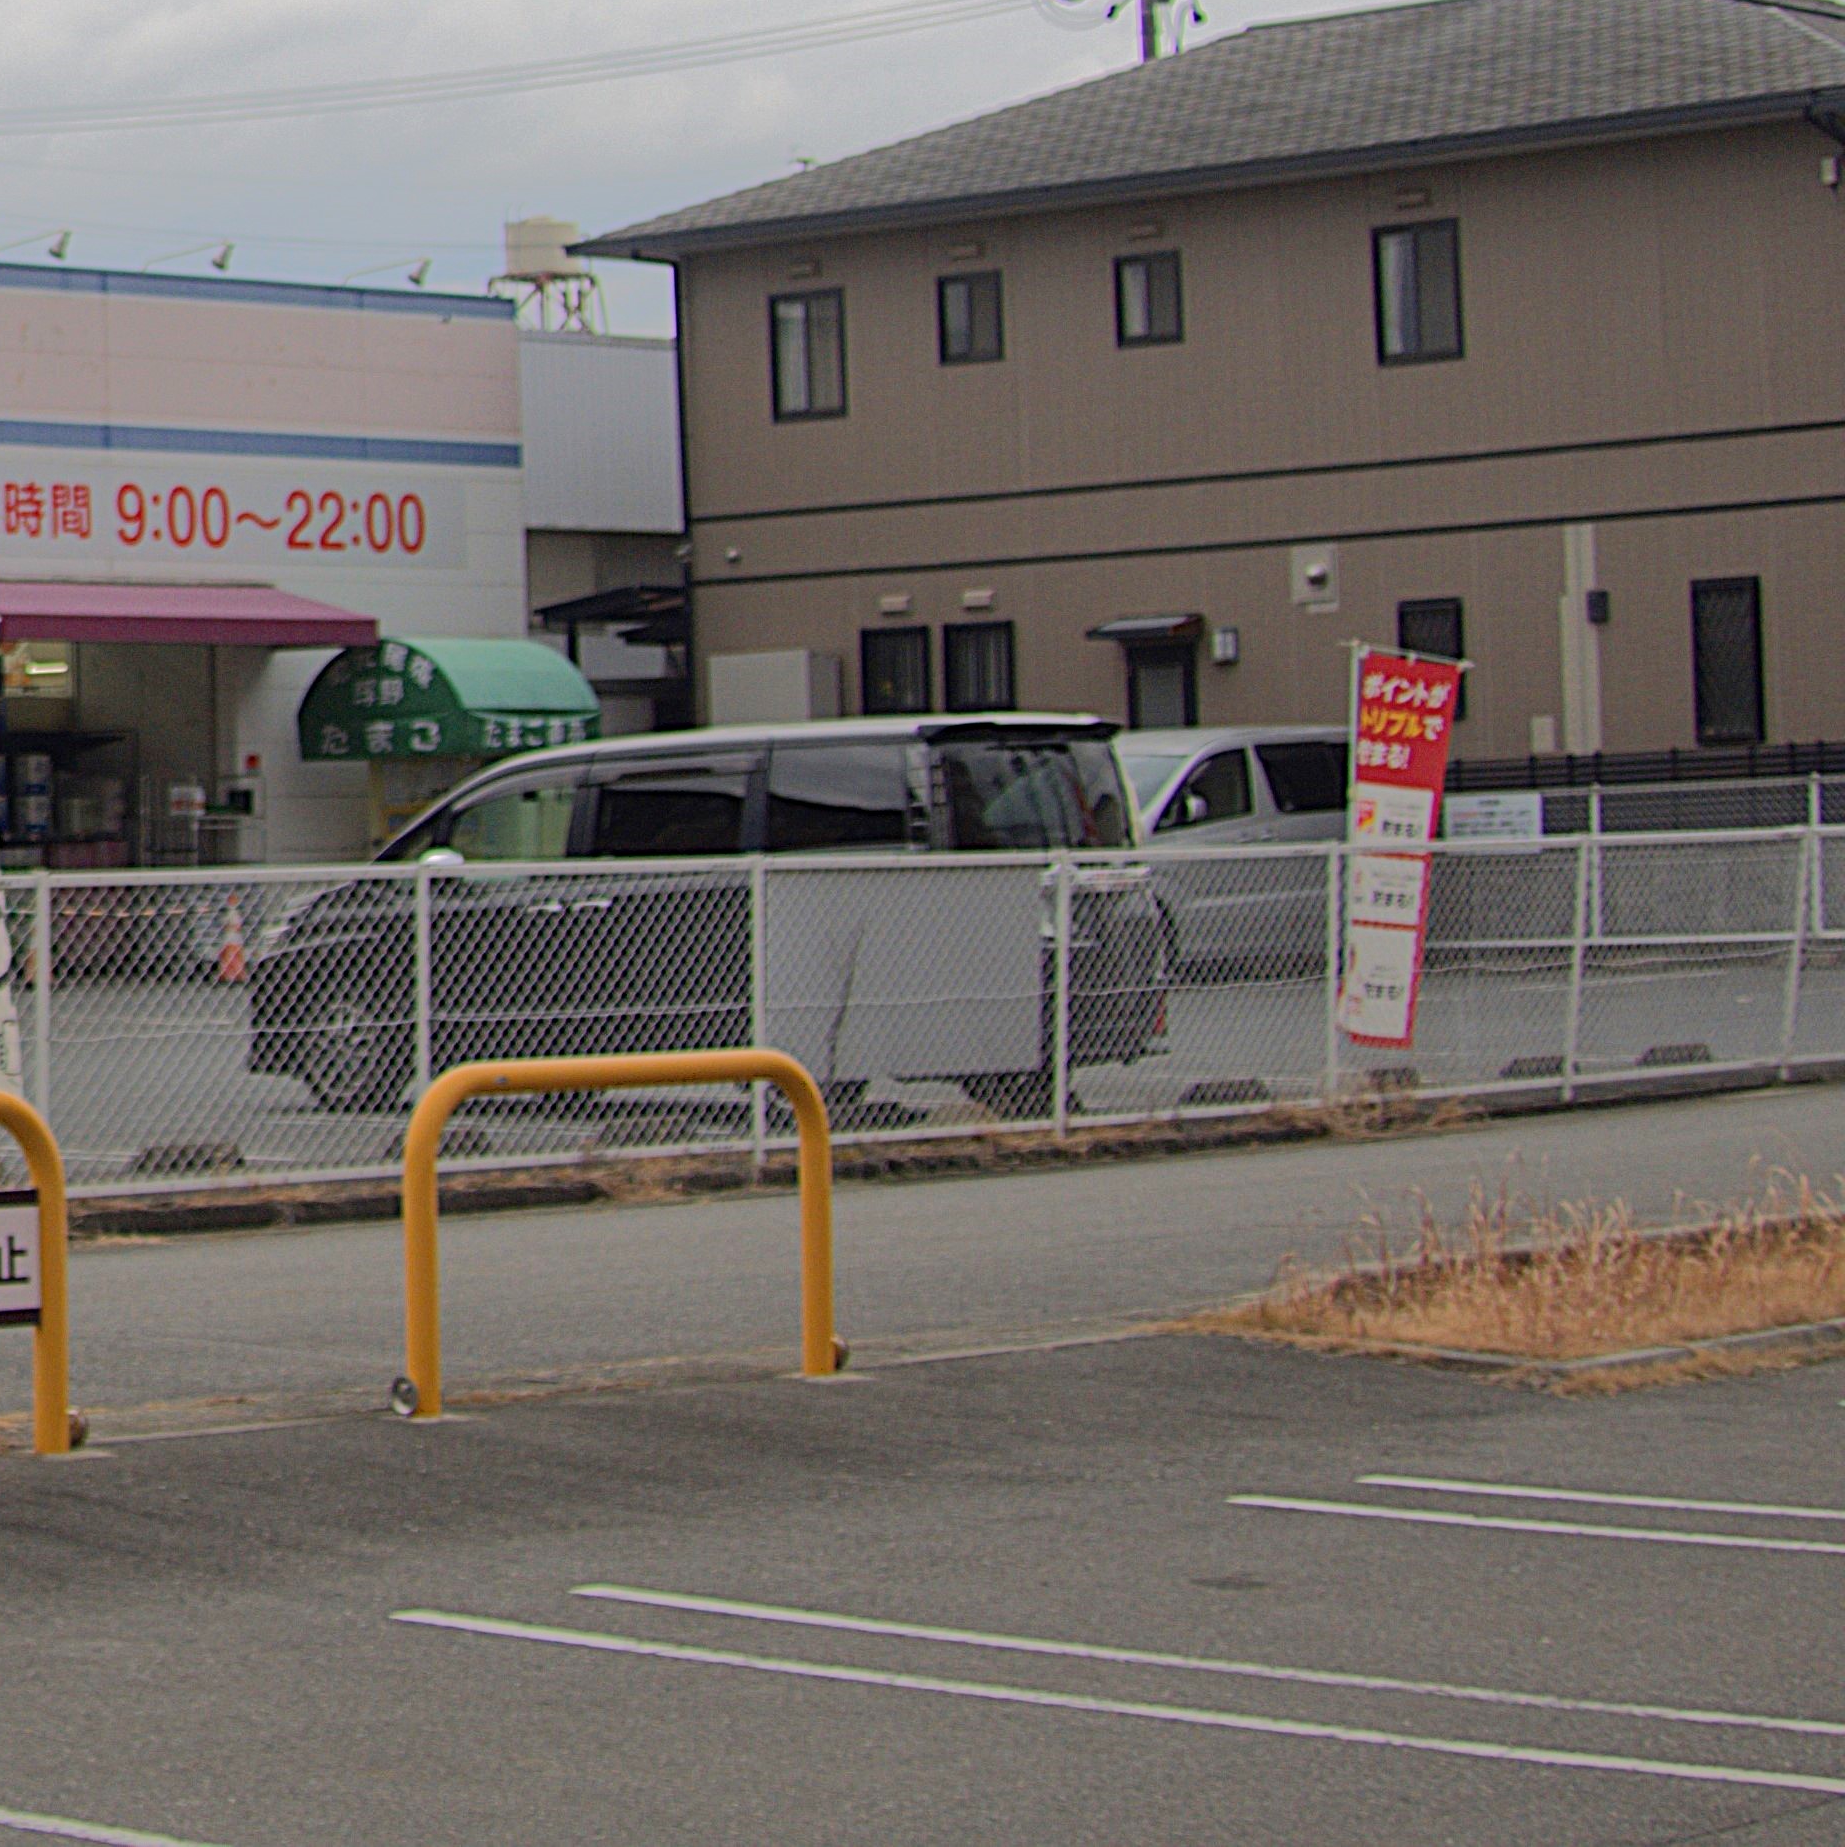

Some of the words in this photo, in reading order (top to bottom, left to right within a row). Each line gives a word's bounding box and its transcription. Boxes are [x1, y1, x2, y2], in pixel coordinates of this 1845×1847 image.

[1362, 672, 1452, 710] ポイントが
[321, 718, 442, 755] たまご
